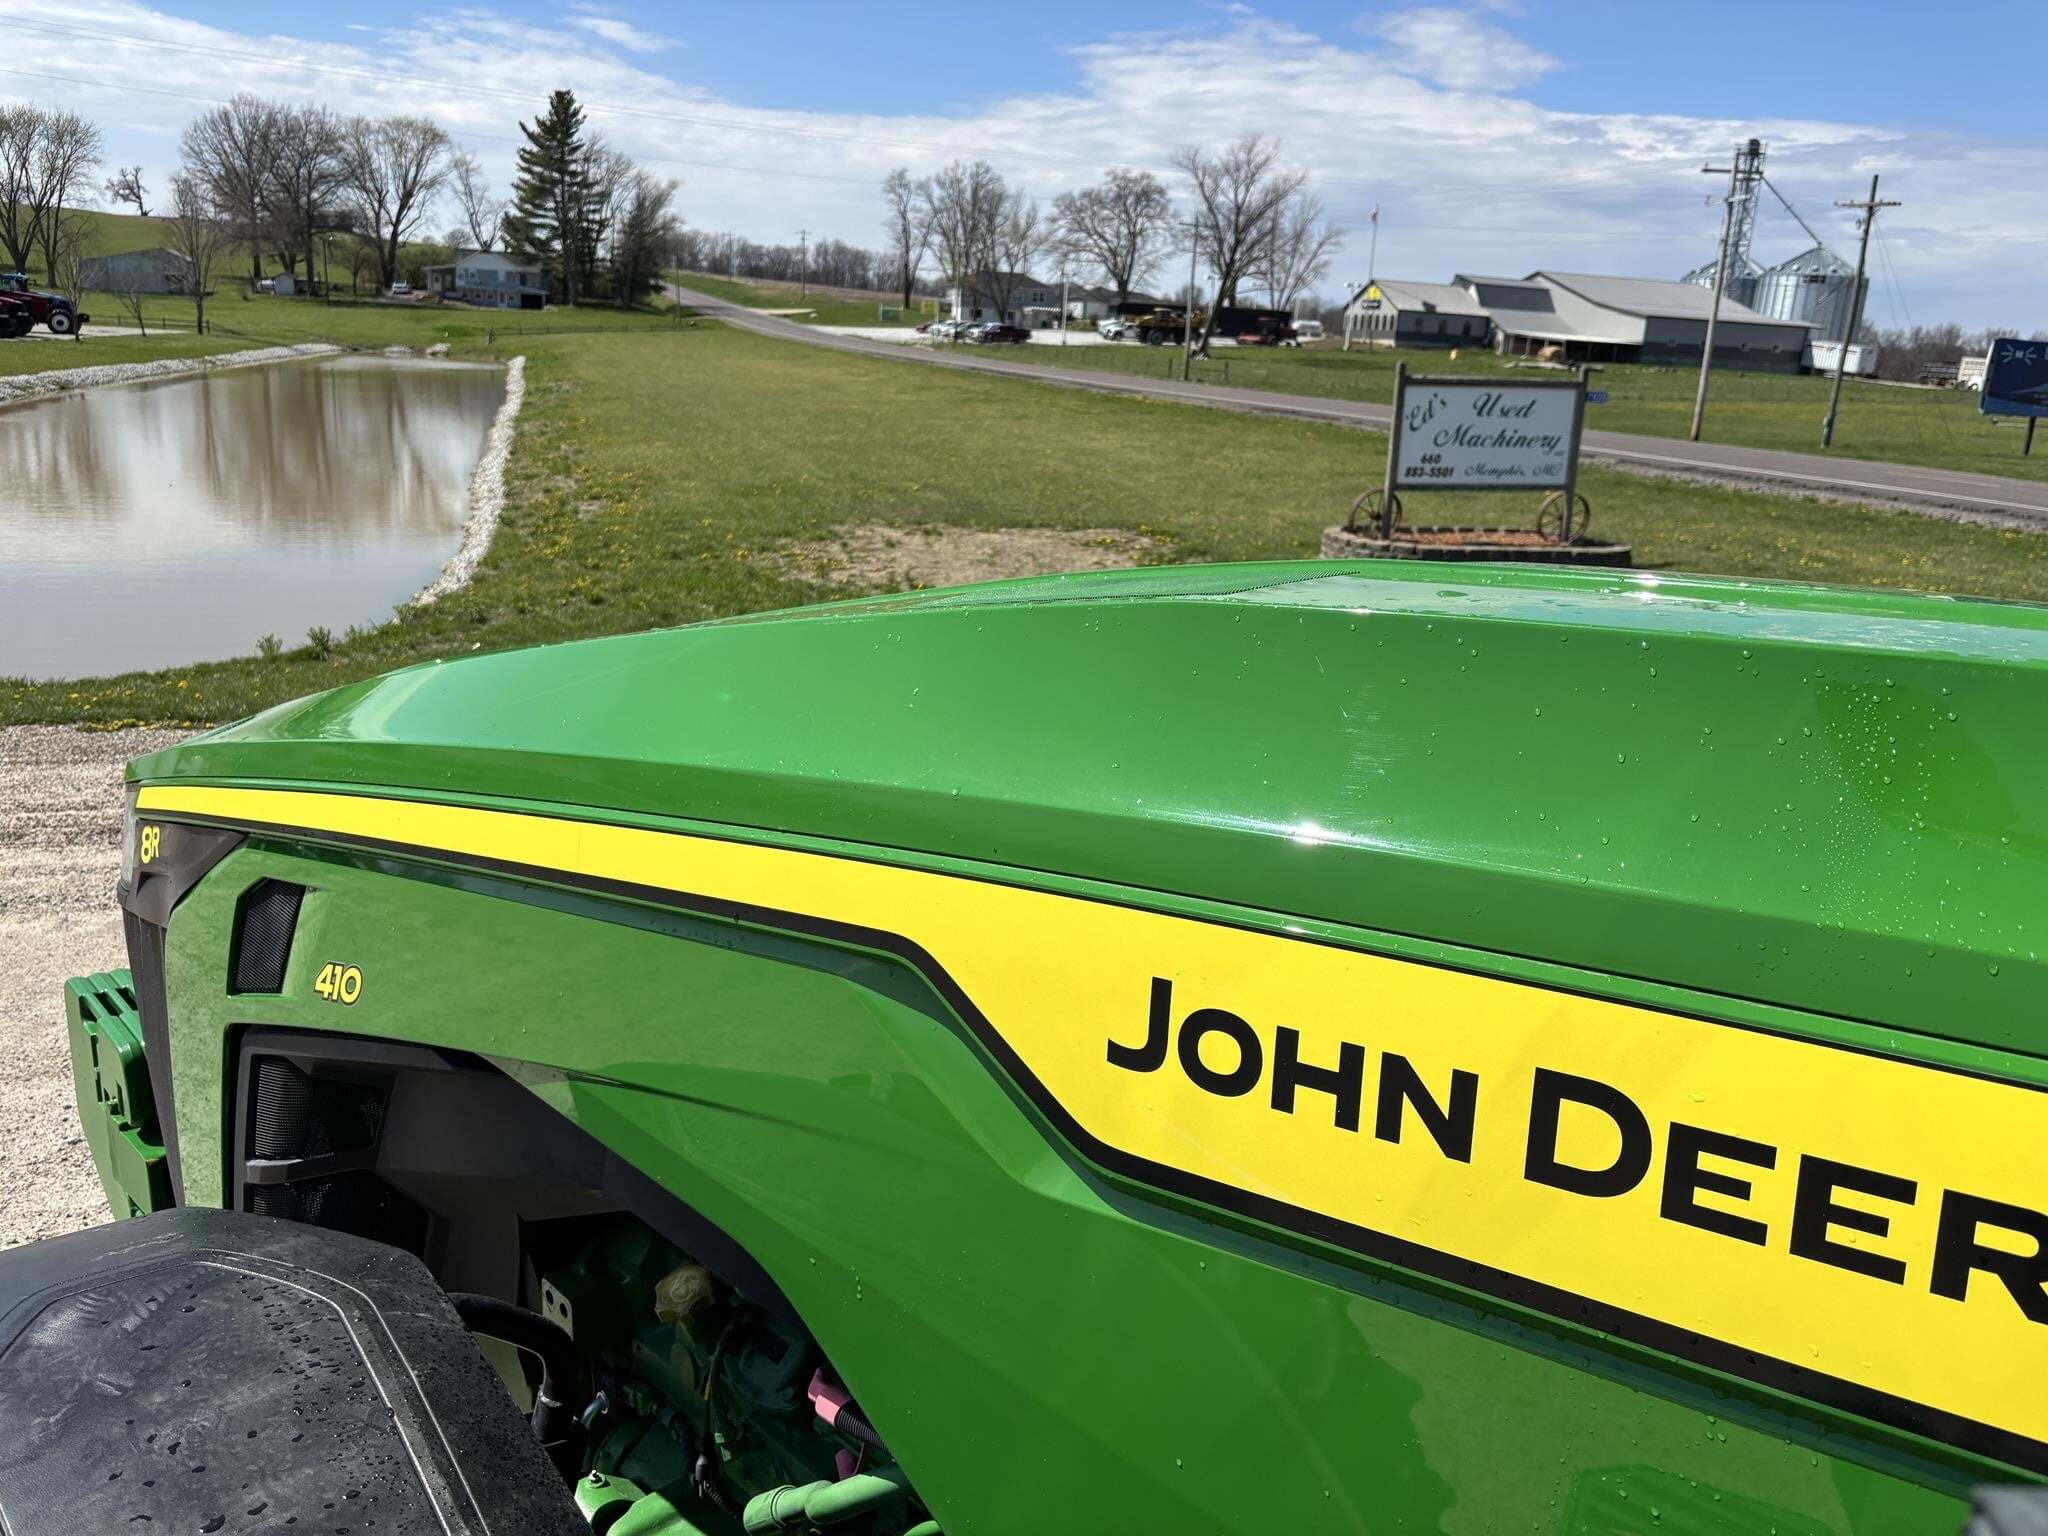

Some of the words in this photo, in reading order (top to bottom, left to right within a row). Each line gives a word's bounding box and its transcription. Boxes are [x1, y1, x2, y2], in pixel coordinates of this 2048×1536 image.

[1472, 393, 1537, 419] Used
[1433, 423, 1562, 456] Machinery
[1420, 453, 1442, 465] 660
[141, 825, 160, 864] 8R
[315, 961, 363, 1005] 410
[1107, 976, 1479, 1164] JOHN
